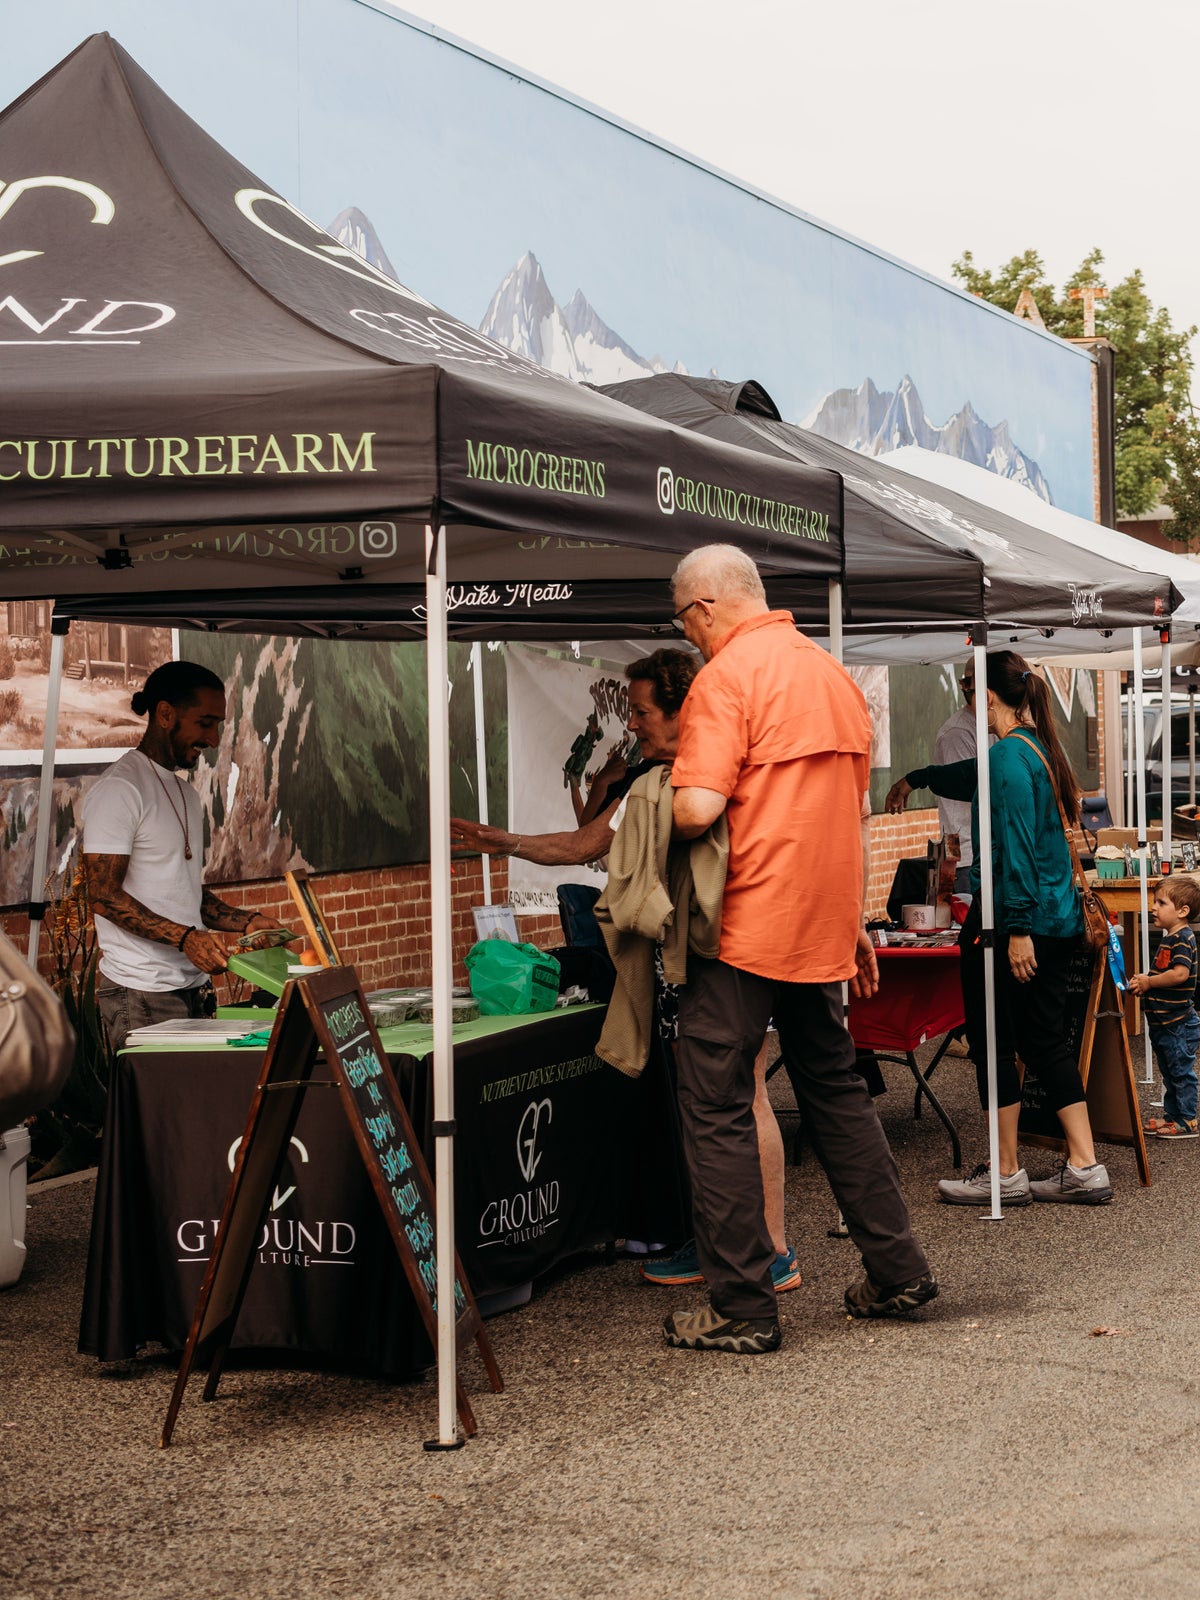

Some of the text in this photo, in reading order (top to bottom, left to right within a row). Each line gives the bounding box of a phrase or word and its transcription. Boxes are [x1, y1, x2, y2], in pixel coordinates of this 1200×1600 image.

[465, 439, 606, 498] MICROGREENS
[674, 476, 829, 543] GROUNDCULTUREFARM
[480, 1070, 528, 1104] NUTRIENT
[527, 1064, 556, 1089] DENSE
[479, 1181, 560, 1236] GROUND
[176, 1218, 356, 1255] GUND
[504, 1222, 546, 1246] CULTURE
